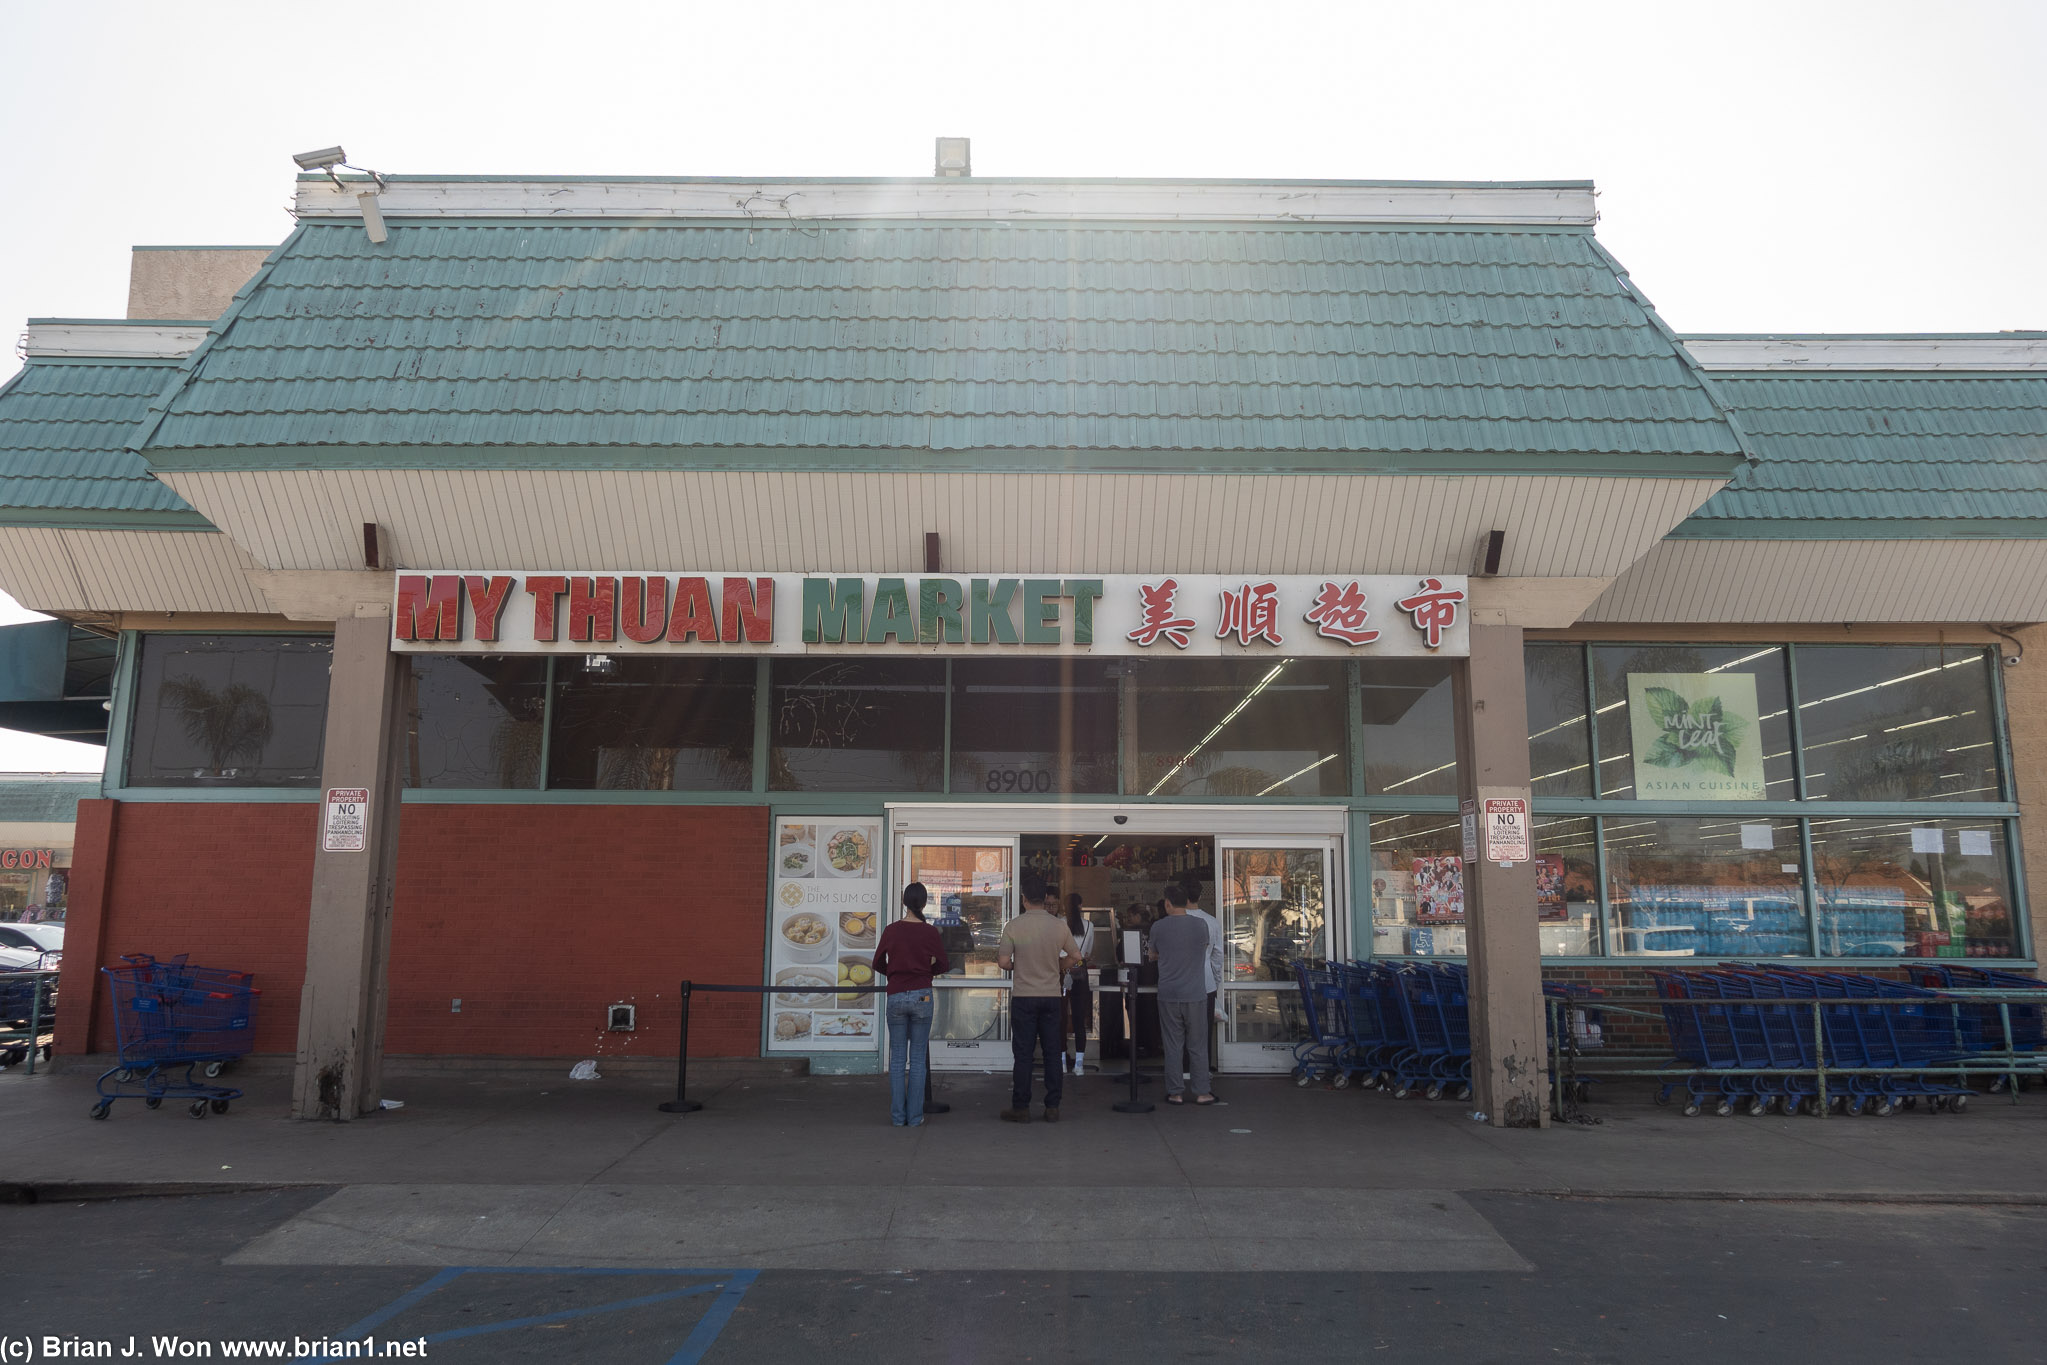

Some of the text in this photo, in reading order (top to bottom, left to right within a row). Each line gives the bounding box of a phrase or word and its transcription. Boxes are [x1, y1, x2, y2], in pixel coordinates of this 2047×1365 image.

[396, 576, 1104, 645] MY THUAN MARKET
[986, 769, 1052, 793] 8900
[1645, 781, 1761, 791] ASIAN CUISINE
[338, 803, 356, 815] NO
[1497, 813, 1515, 825] NO
[0, 849, 53, 868] GON
[807, 893, 830, 903] DIM
[832, 893, 857, 903] SUM
